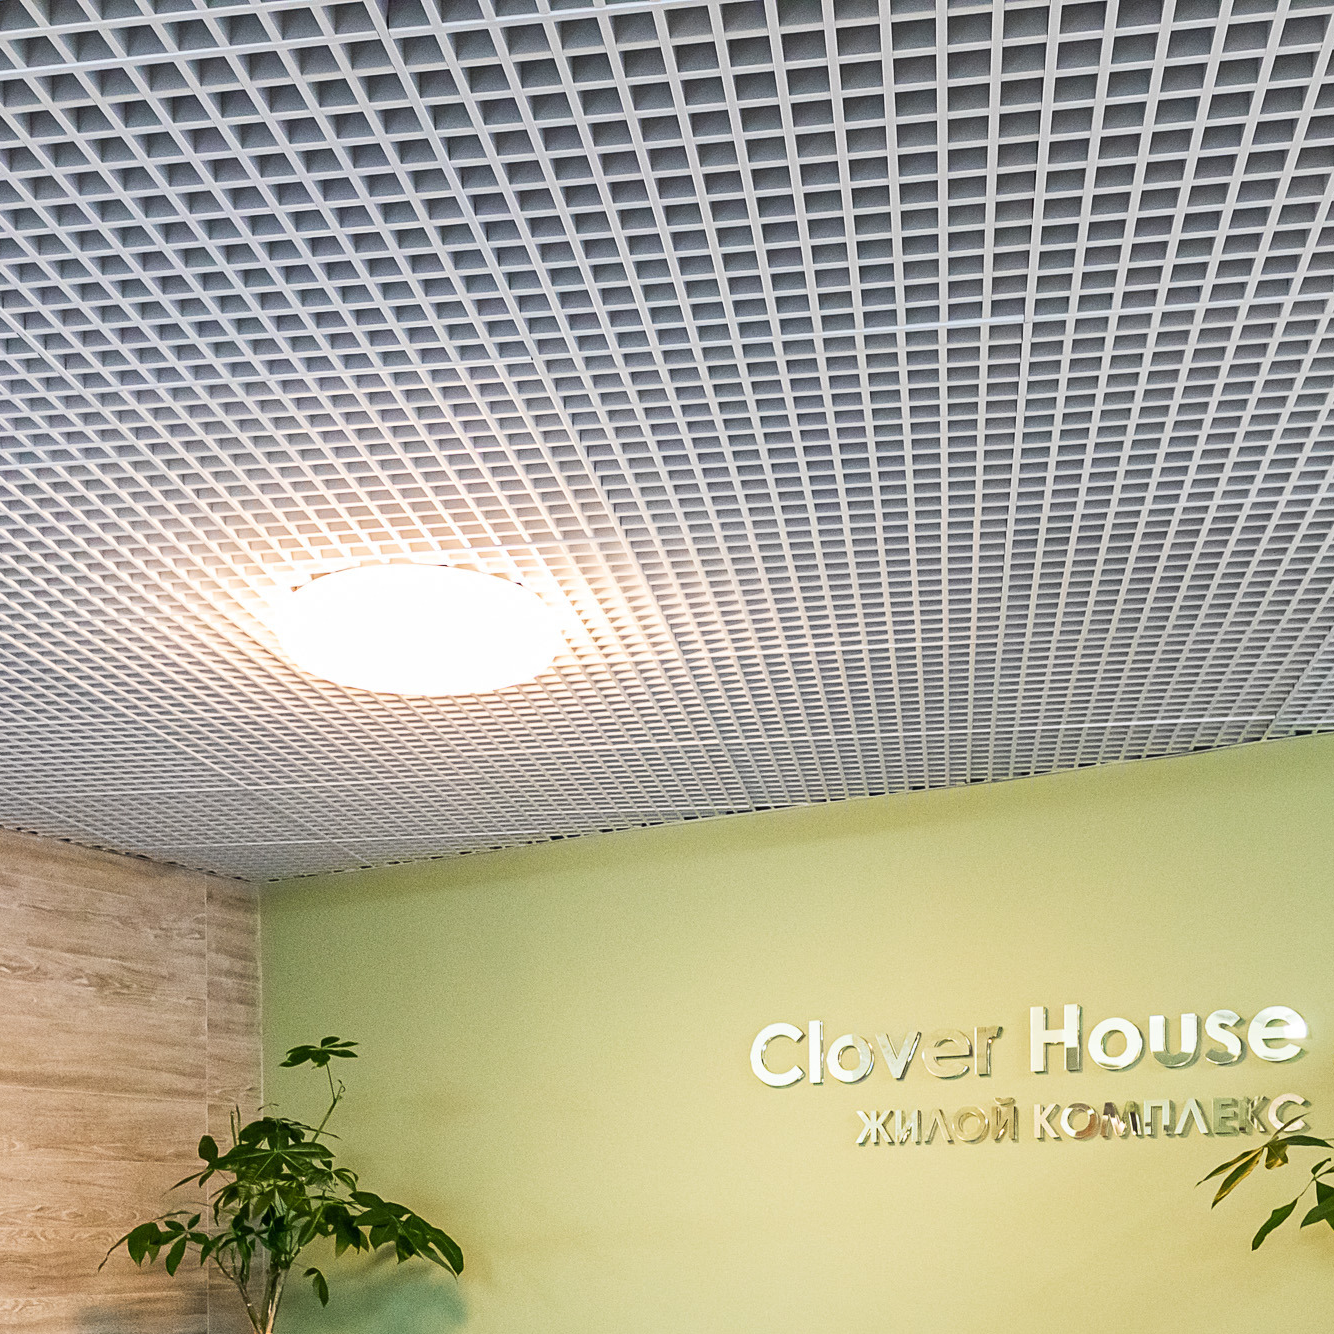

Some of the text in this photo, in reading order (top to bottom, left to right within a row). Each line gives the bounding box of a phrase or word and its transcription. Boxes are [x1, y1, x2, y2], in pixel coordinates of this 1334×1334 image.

[750, 1003, 1309, 1089] Clover House
[854, 1092, 1312, 1147] ЖИЛОЙ КОМПЛЕКС
